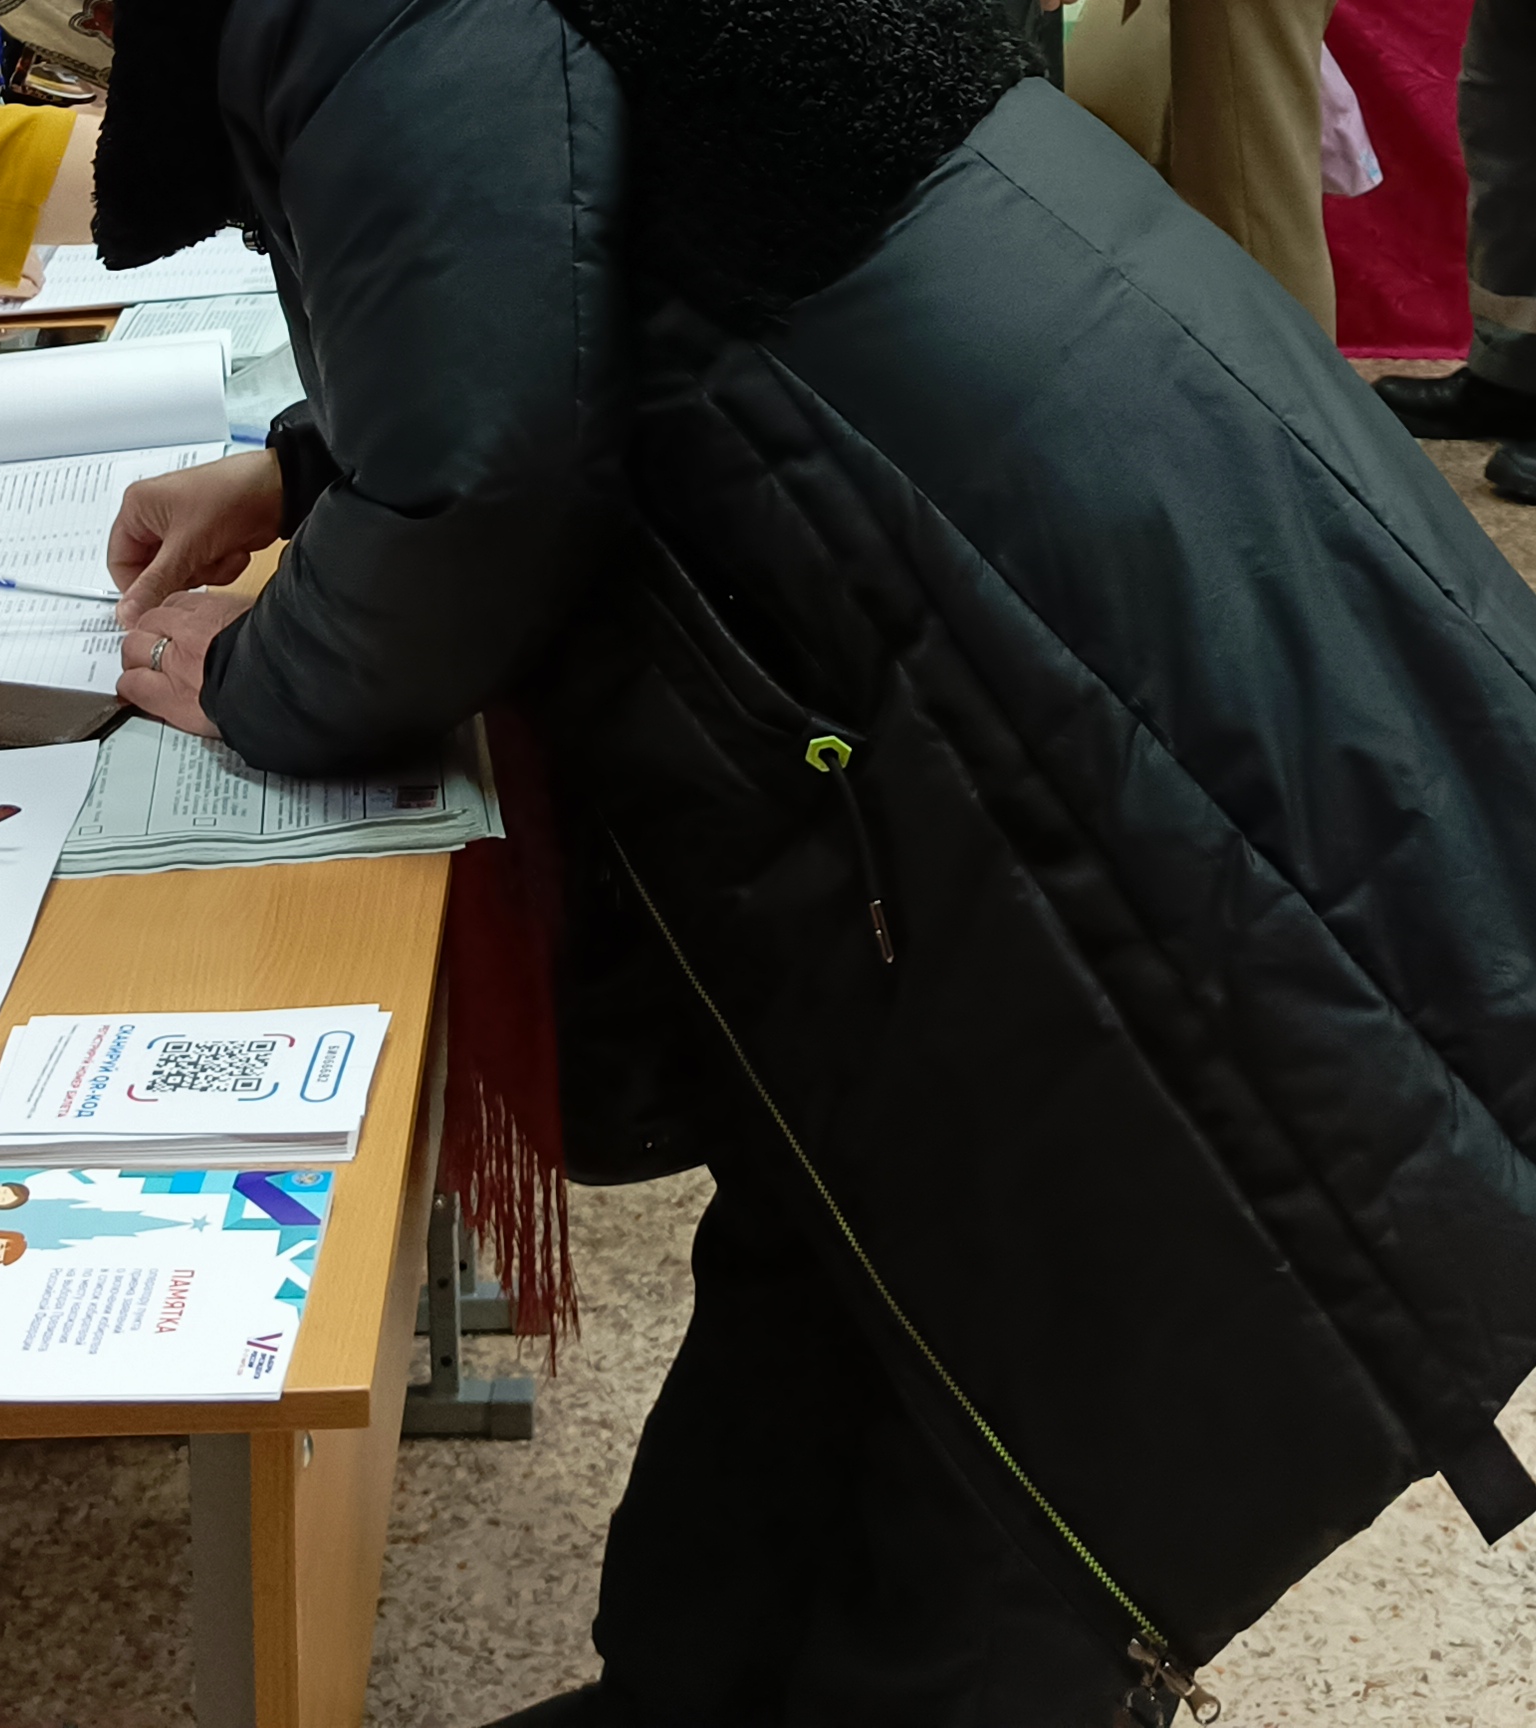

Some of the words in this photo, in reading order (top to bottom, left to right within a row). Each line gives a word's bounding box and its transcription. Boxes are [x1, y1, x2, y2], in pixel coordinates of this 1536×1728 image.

[99, 1024, 136, 1073] СКАНИРУЙ
[74, 1076, 110, 1119] QR-КОД
[154, 1269, 196, 1334] ПАМЯТКА
